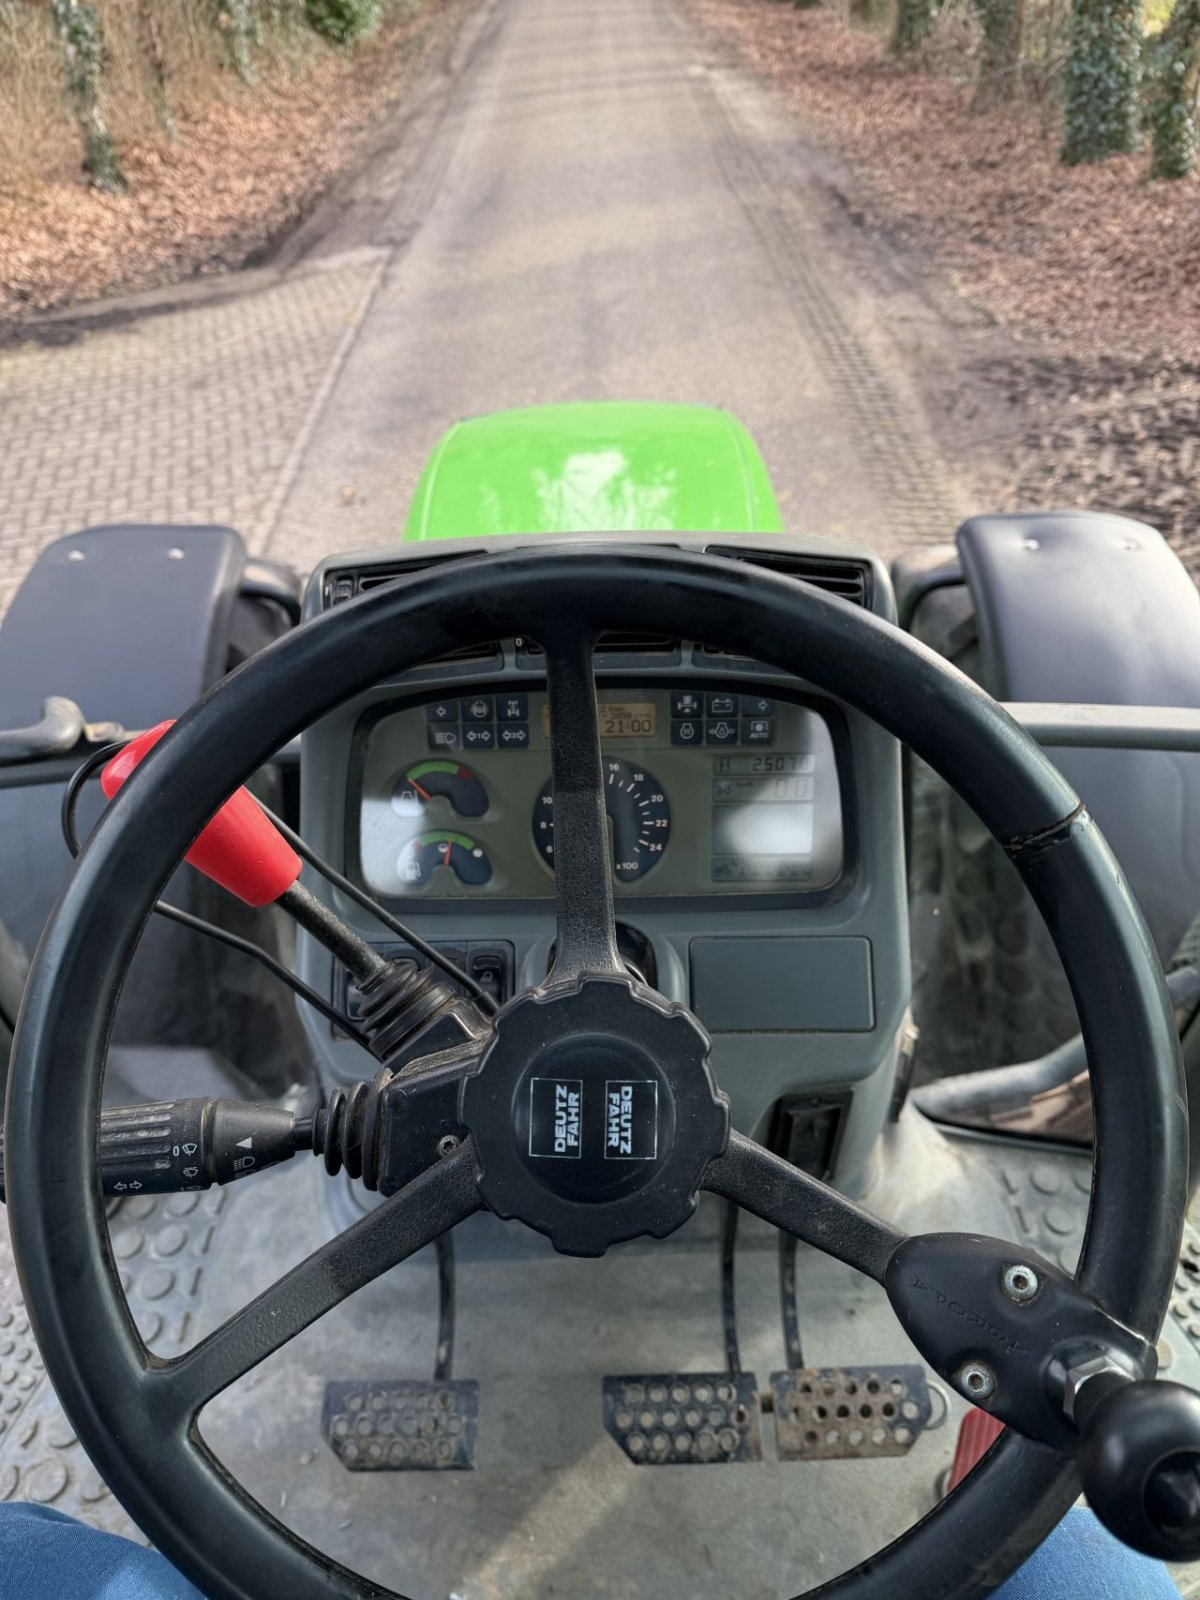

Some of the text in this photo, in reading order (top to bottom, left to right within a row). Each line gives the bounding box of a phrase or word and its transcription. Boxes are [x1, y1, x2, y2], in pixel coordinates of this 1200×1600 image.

[605, 720, 651, 733] 21:00
[609, 763, 620, 772] 16
[634, 774, 644, 782] 18
[542, 796, 552, 804] 10
[650, 843, 662, 851] 24
[555, 1084, 567, 1152] DEUTZ
[567, 1092, 580, 1146] FAHR
[608, 1093, 620, 1147] FAHR
[620, 1086, 632, 1154] DEUTZ
